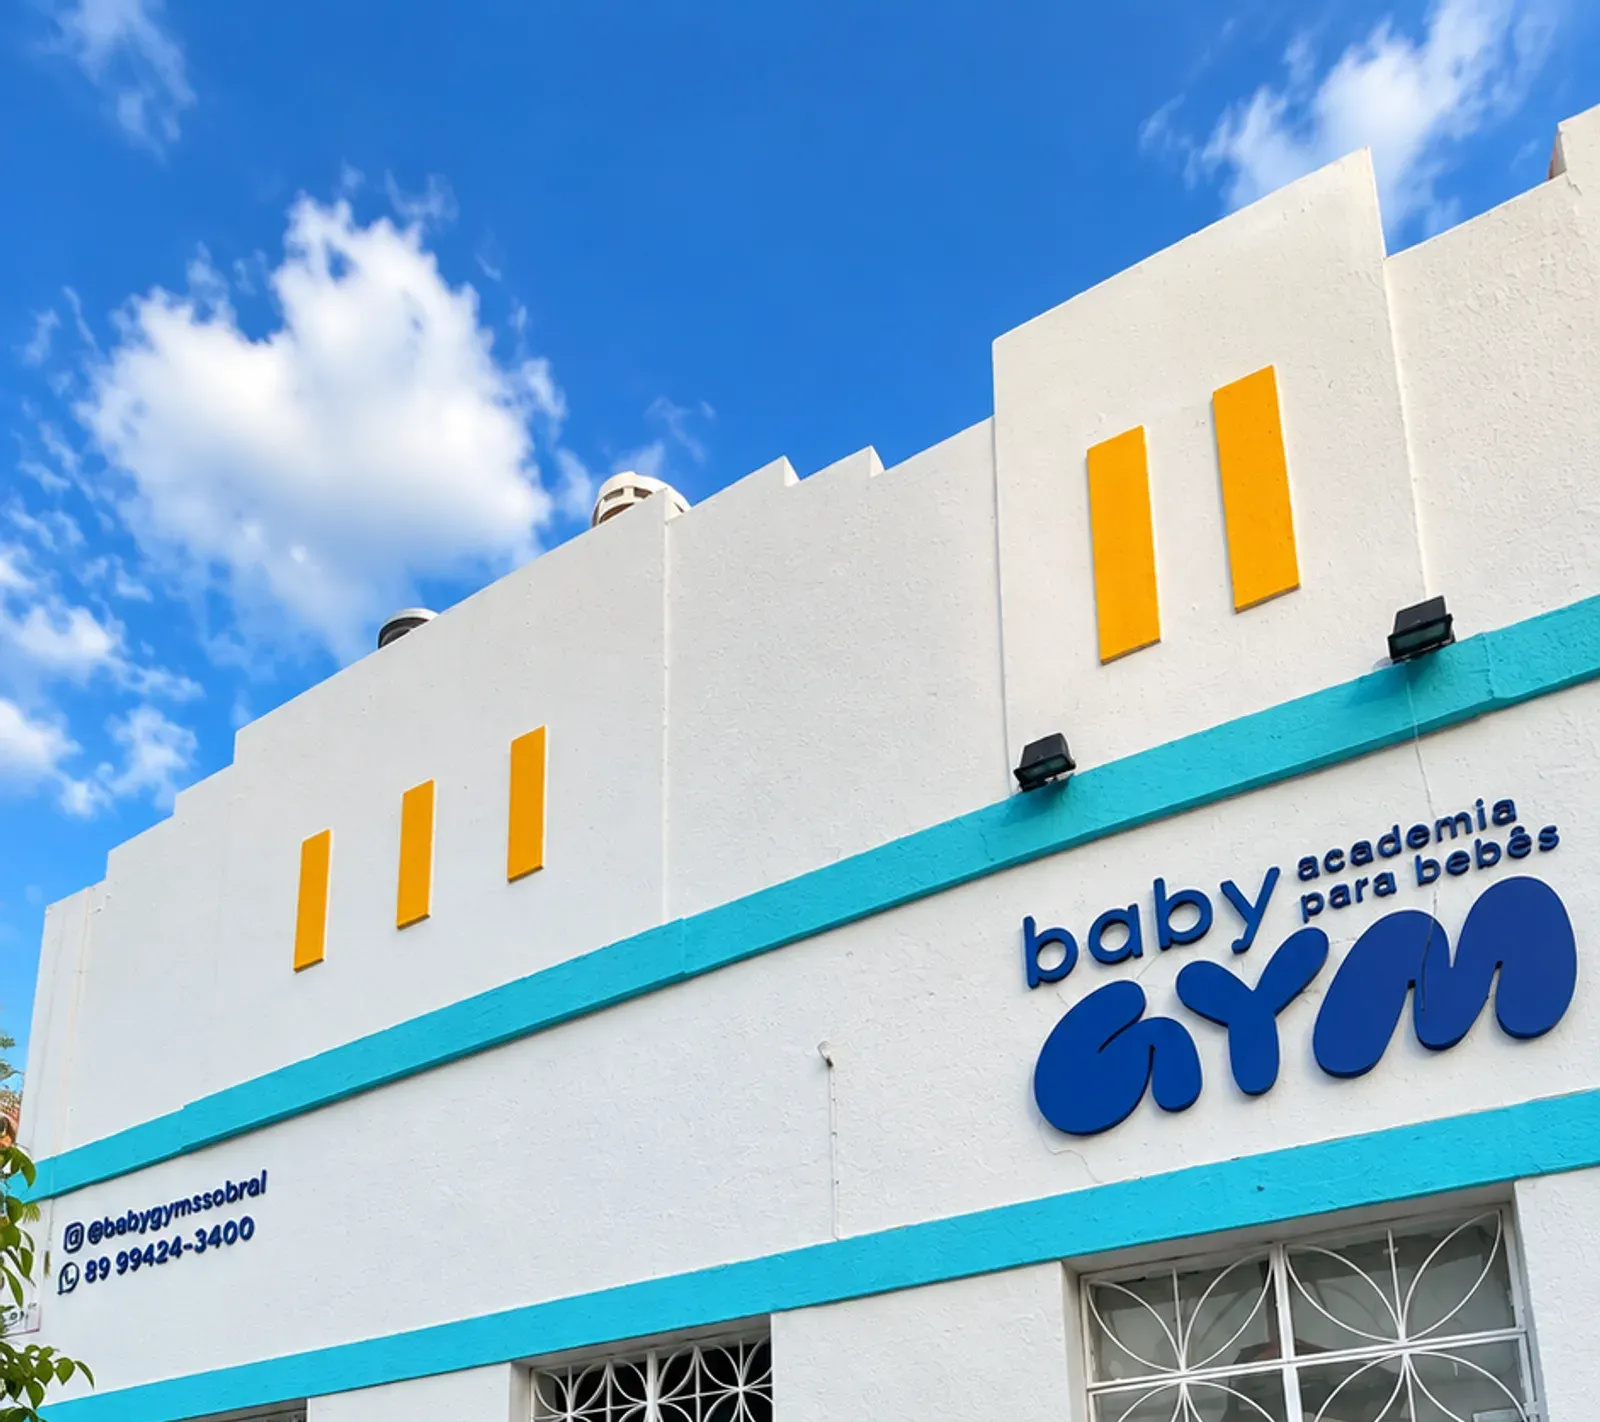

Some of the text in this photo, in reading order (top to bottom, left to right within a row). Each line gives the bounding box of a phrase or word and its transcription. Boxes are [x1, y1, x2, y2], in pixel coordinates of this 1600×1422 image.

[1298, 799, 1518, 881] academia
[1300, 824, 1561, 924] para bebês
[1022, 865, 1282, 990] baby
[88, 1169, 267, 1244] @babygymssobral
[85, 1216, 255, 1283] 89 99424-3400
